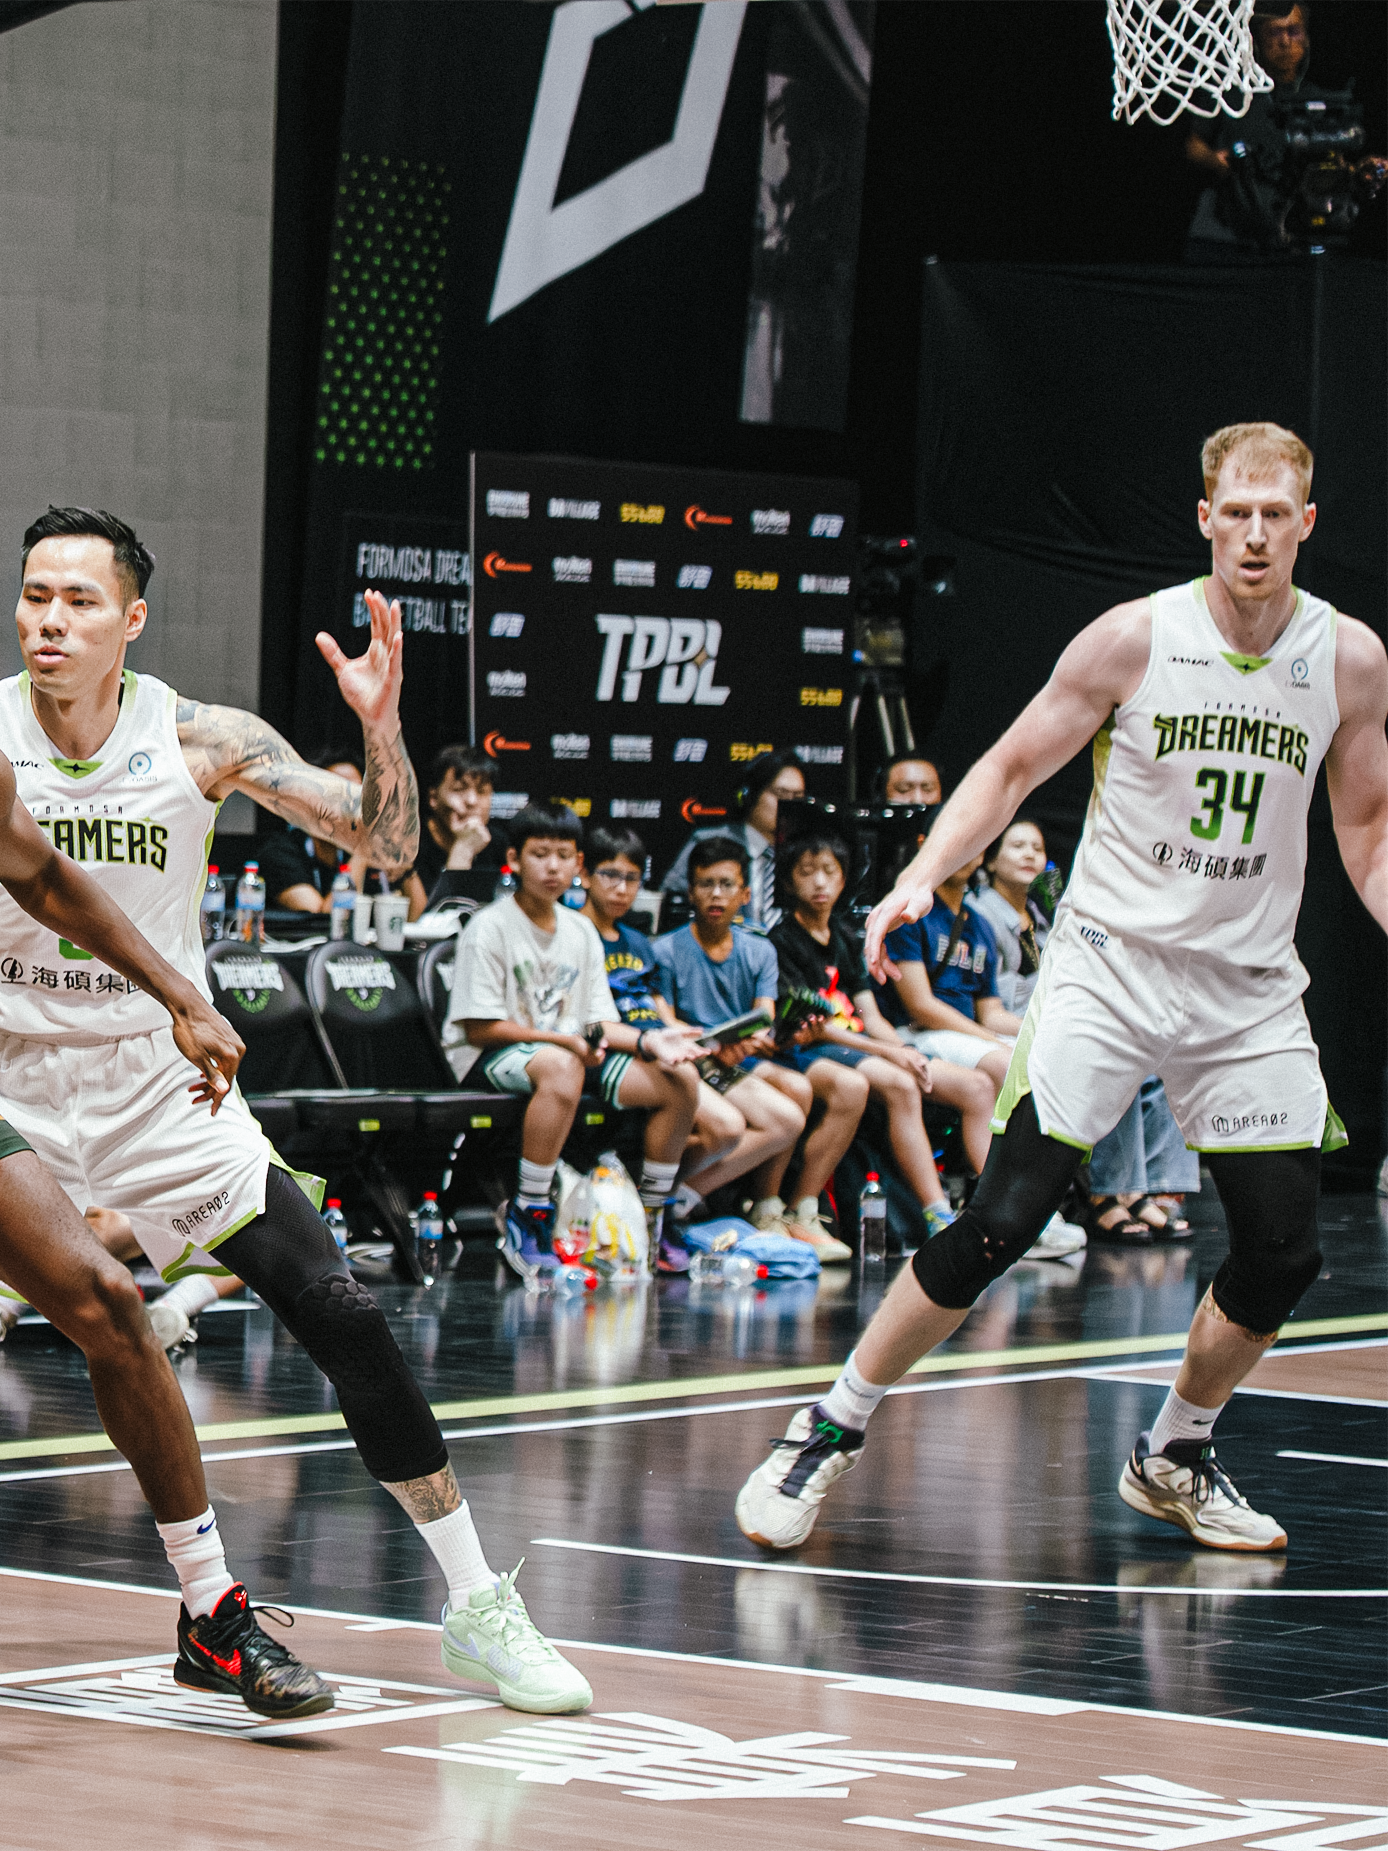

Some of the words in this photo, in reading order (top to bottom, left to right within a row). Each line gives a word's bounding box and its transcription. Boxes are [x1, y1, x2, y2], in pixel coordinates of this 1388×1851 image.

[356, 542, 432, 582] FORMOSA
[596, 613, 730, 706] TPBL
[1153, 712, 1309, 778] DREAMERS
[1190, 767, 1267, 845] 34
[37, 817, 169, 874] AMERS
[1178, 846, 1268, 881] 海碩集團
